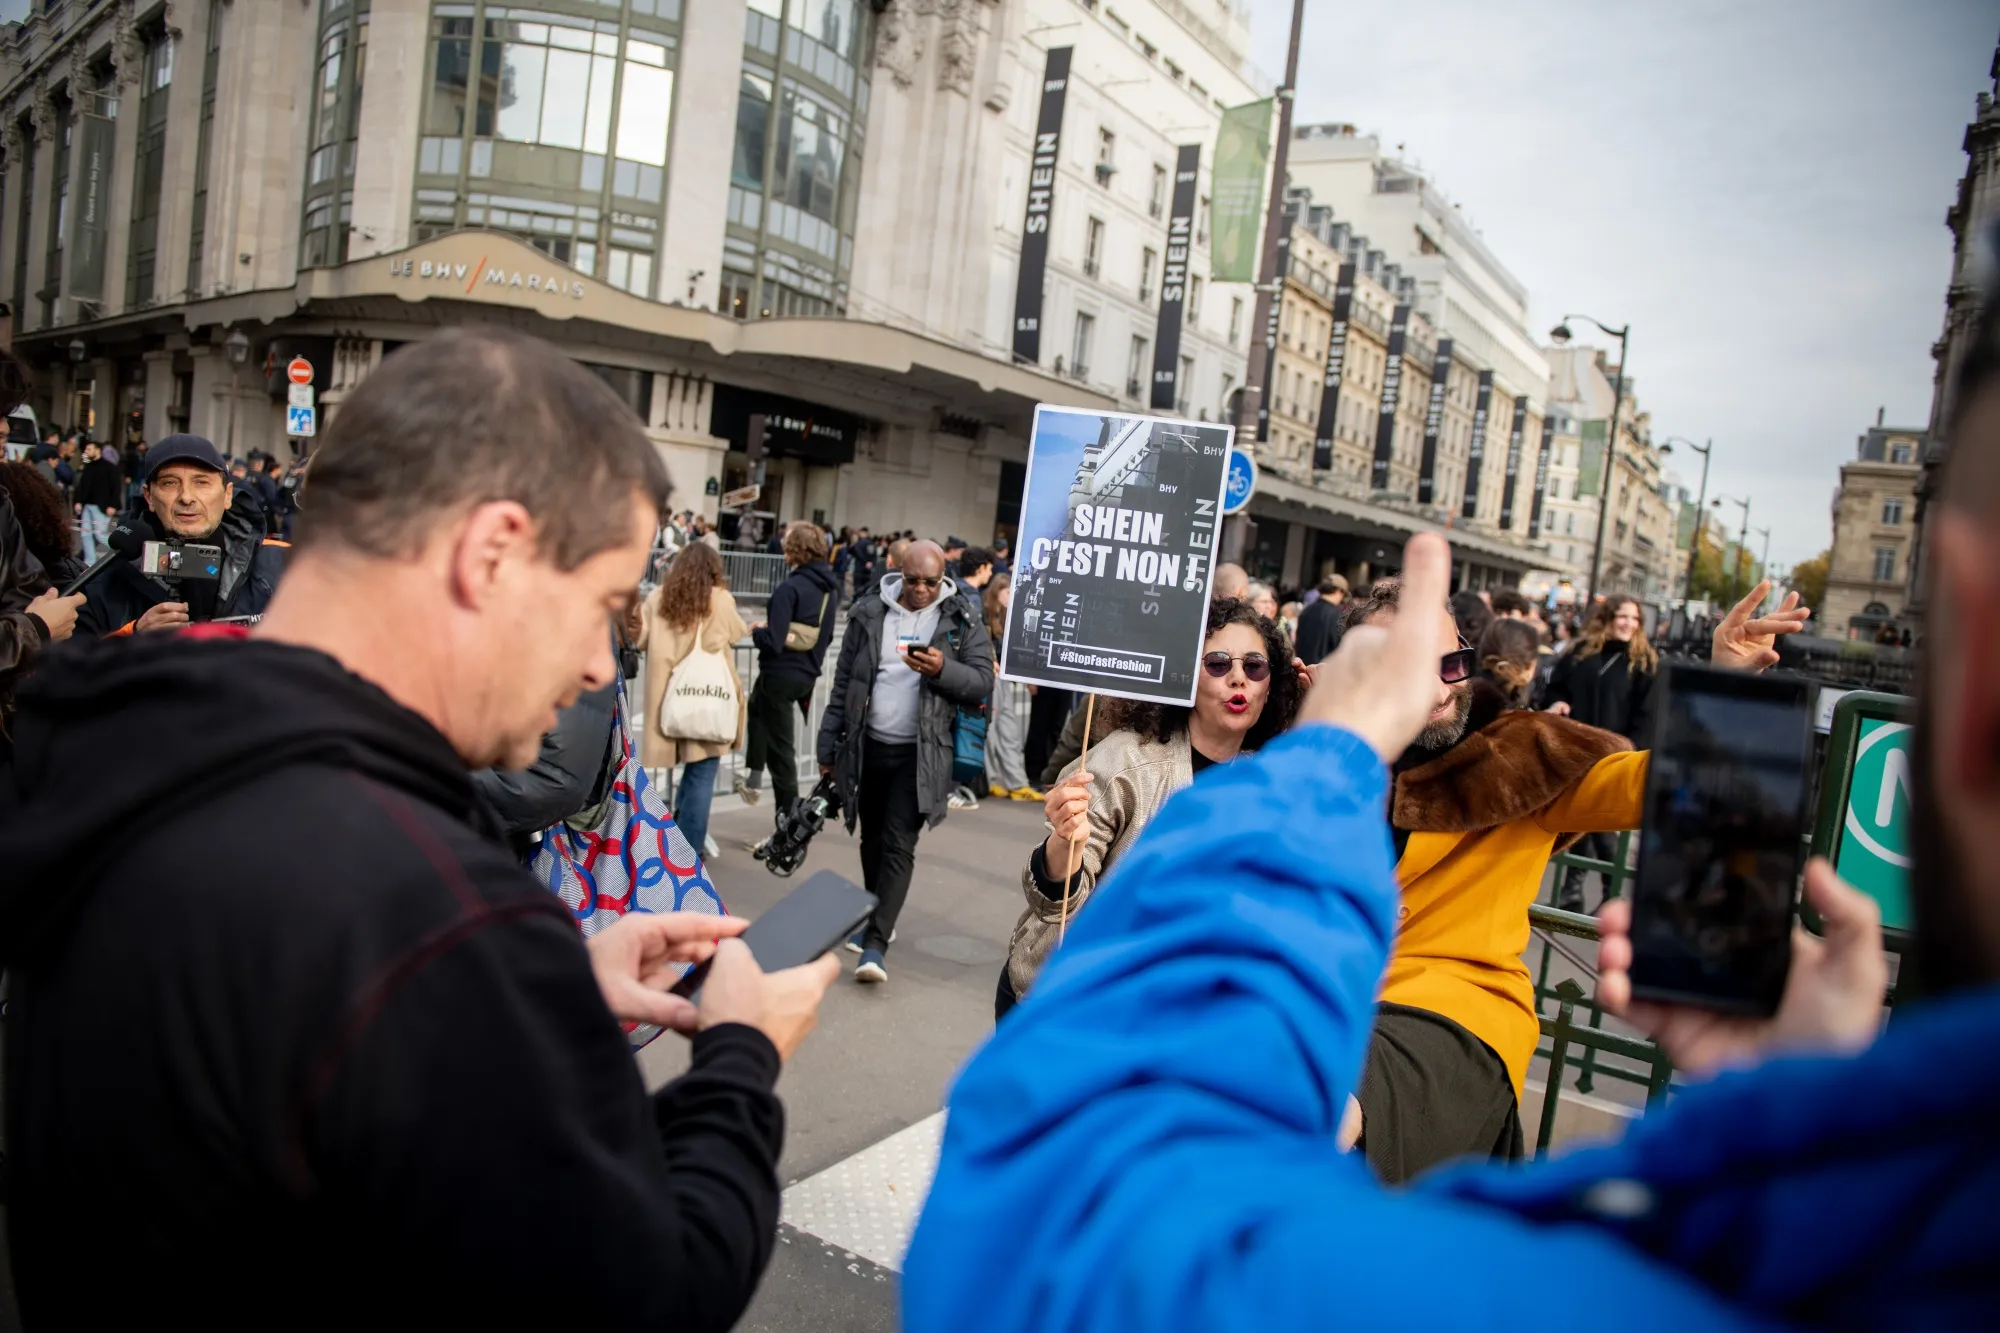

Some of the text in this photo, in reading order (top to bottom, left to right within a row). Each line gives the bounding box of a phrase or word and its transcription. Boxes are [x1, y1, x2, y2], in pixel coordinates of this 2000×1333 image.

[1026, 132, 1057, 234] SHEIN
[390, 258, 585, 299] LE BHV MARAIS
[1163, 216, 1190, 302] SHEIN
[1325, 321, 1346, 387] SHEIN
[1381, 355, 1401, 414] SHEIN
[1203, 445, 1225, 457] BHV
[1159, 483, 1178, 494] BHV
[1073, 503, 1164, 546] SHEIN
[1031, 537, 1113, 578] C'EST
[1116, 548, 1180, 587] NON
[1048, 577, 1062, 586] BHV
[1060, 650, 1152, 674] #StopFastFashion
[676, 684, 730, 701] vinokilo
